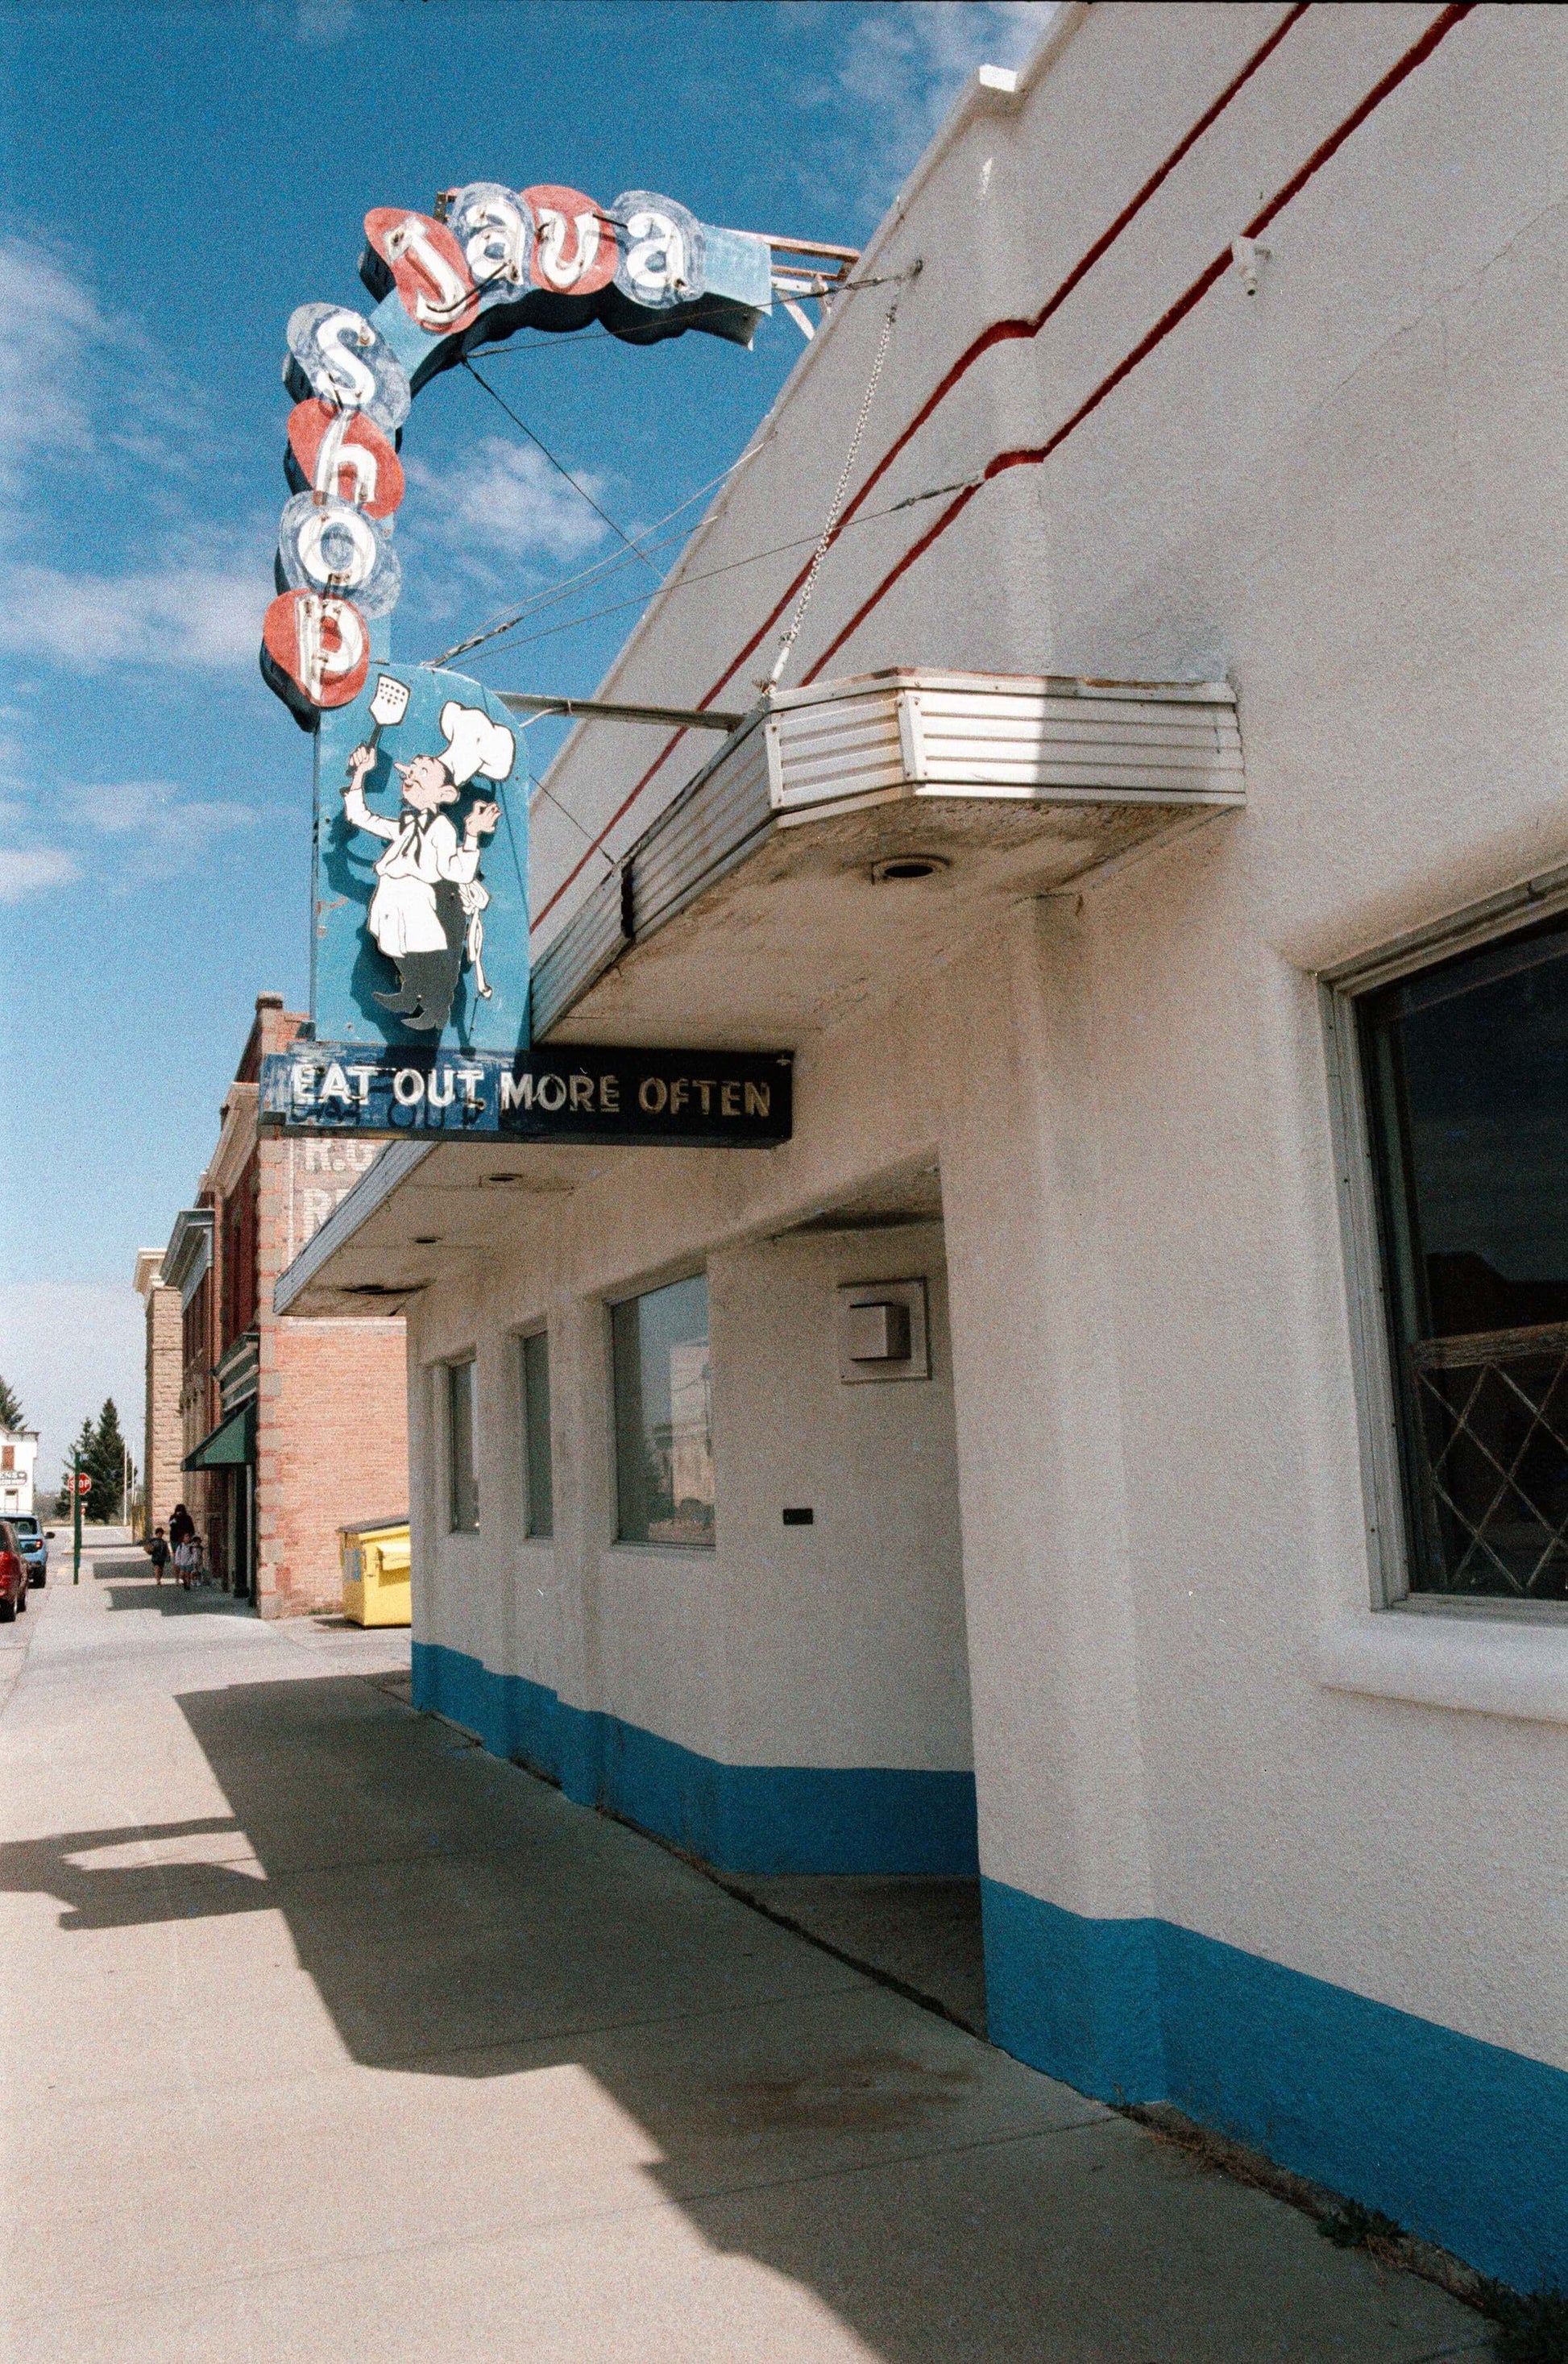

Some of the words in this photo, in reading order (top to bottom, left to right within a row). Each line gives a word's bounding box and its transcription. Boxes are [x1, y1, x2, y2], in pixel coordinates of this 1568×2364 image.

[383, 197, 688, 324] Java
[295, 317, 379, 706] Shop
[292, 1062, 379, 1105] EAT
[392, 1068, 485, 1109] OUT
[500, 1072, 620, 1113] MORE
[638, 1076, 771, 1118] OFTEN
[69, 1479, 90, 1488] SOP
